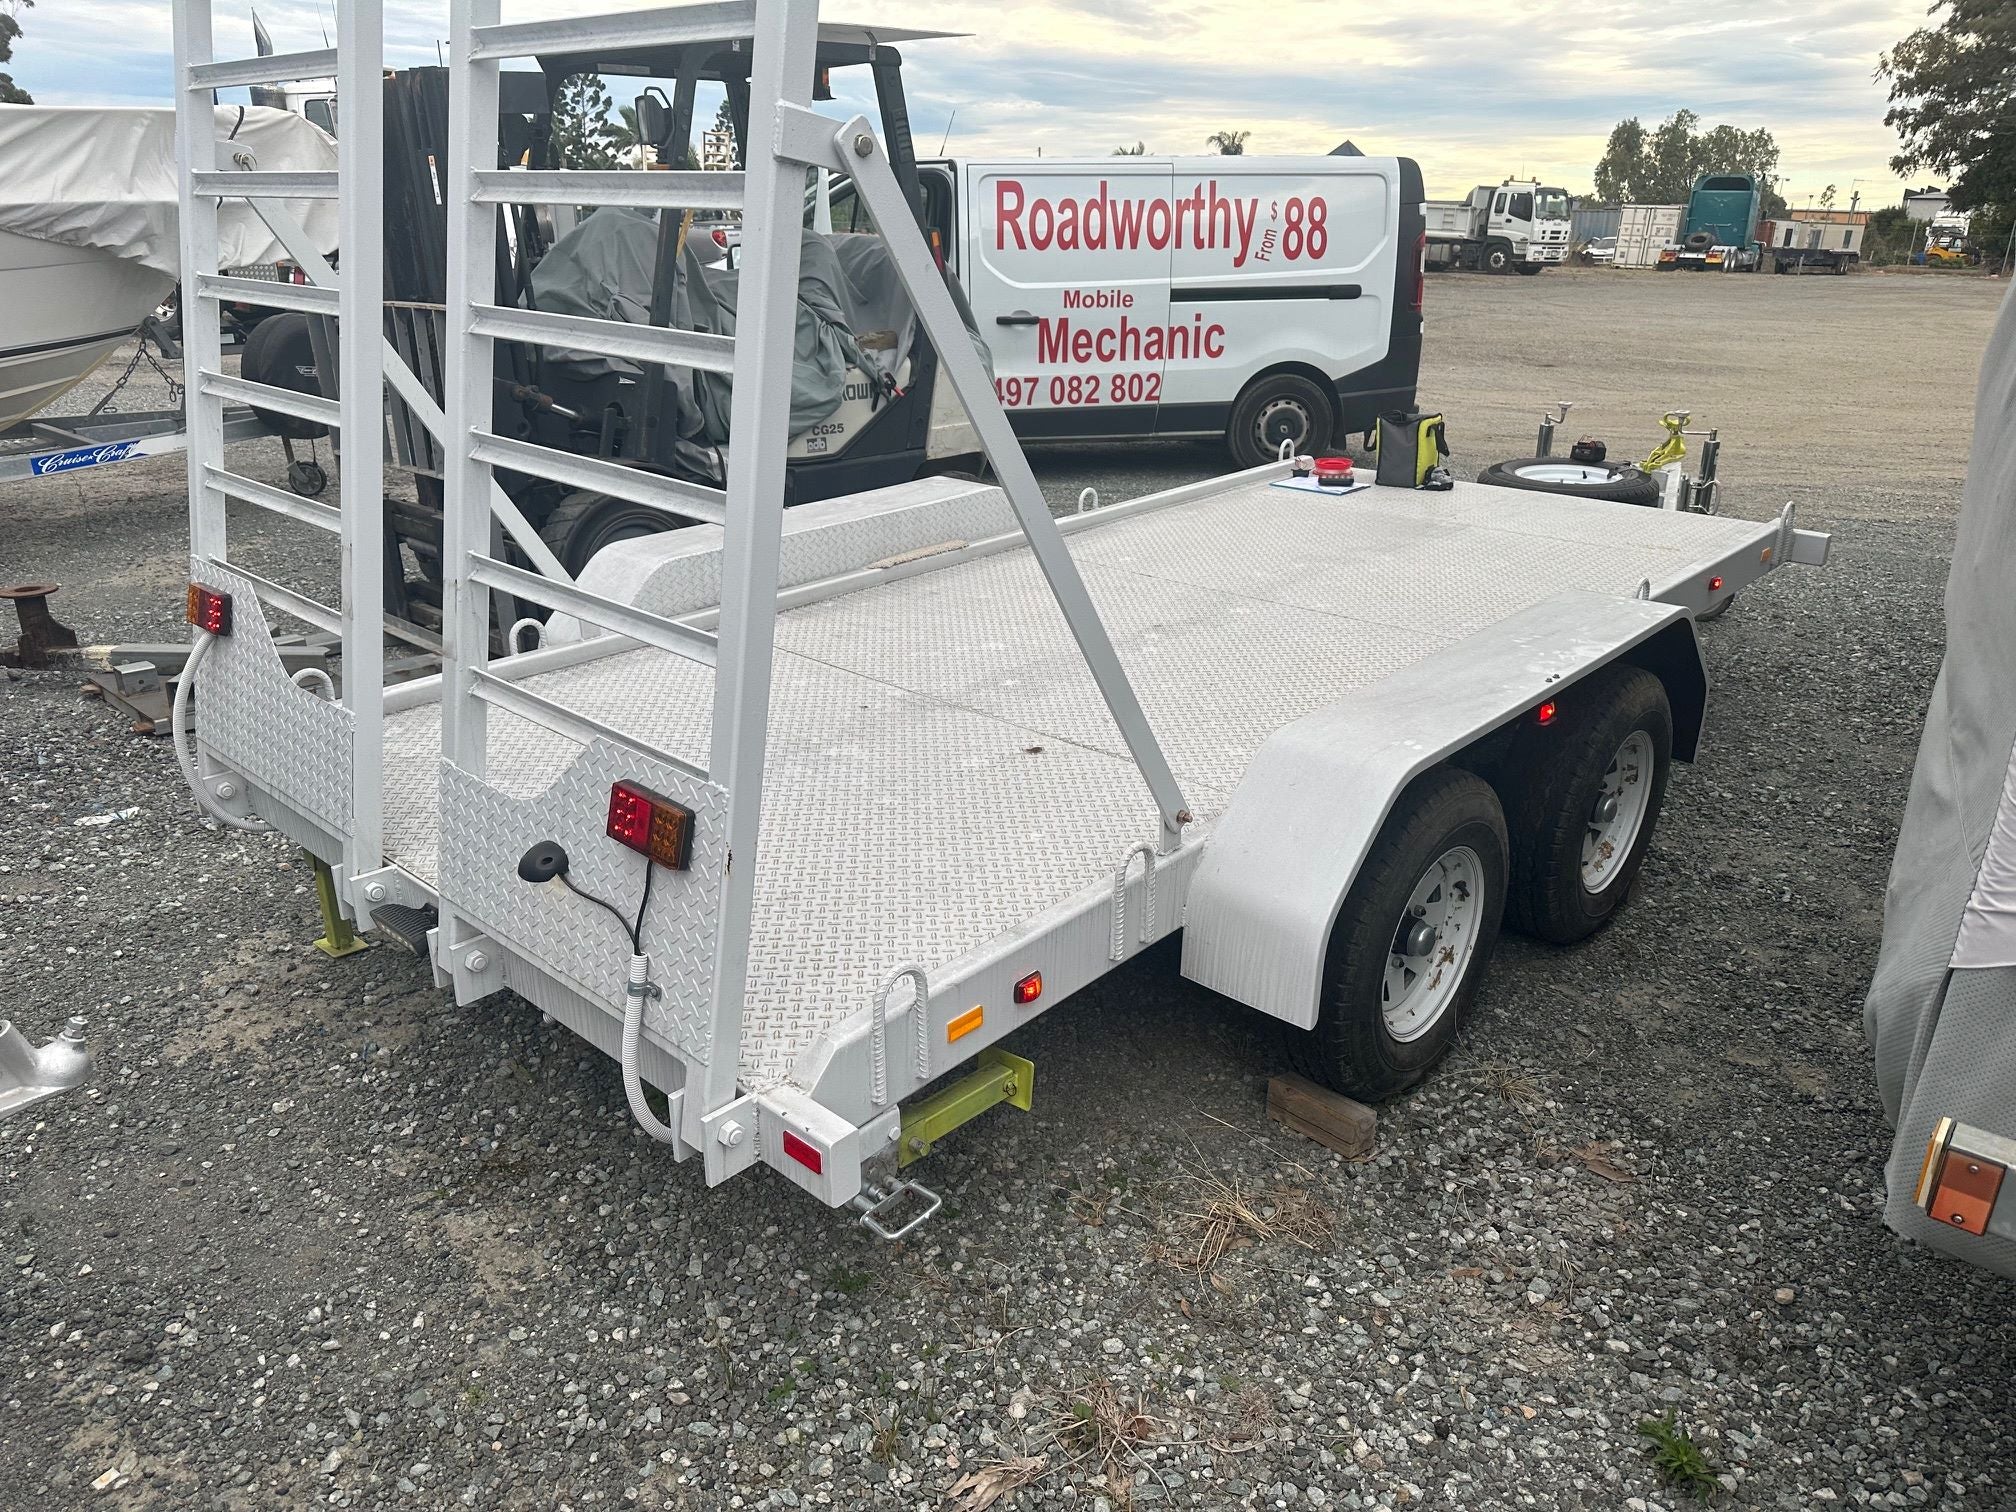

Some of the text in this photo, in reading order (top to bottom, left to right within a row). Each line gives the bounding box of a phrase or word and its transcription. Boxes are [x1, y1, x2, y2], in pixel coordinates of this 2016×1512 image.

[996, 180, 1258, 267] Roadworthy
[1254, 229, 1278, 262] From
[1063, 290, 1133, 308] Mobile
[1038, 314, 1225, 364] Mechanic
[1050, 375, 1100, 405] 082
[1110, 373, 1161, 403] 802
[812, 423, 844, 436] CG25
[38, 454, 91, 474] Cruise
